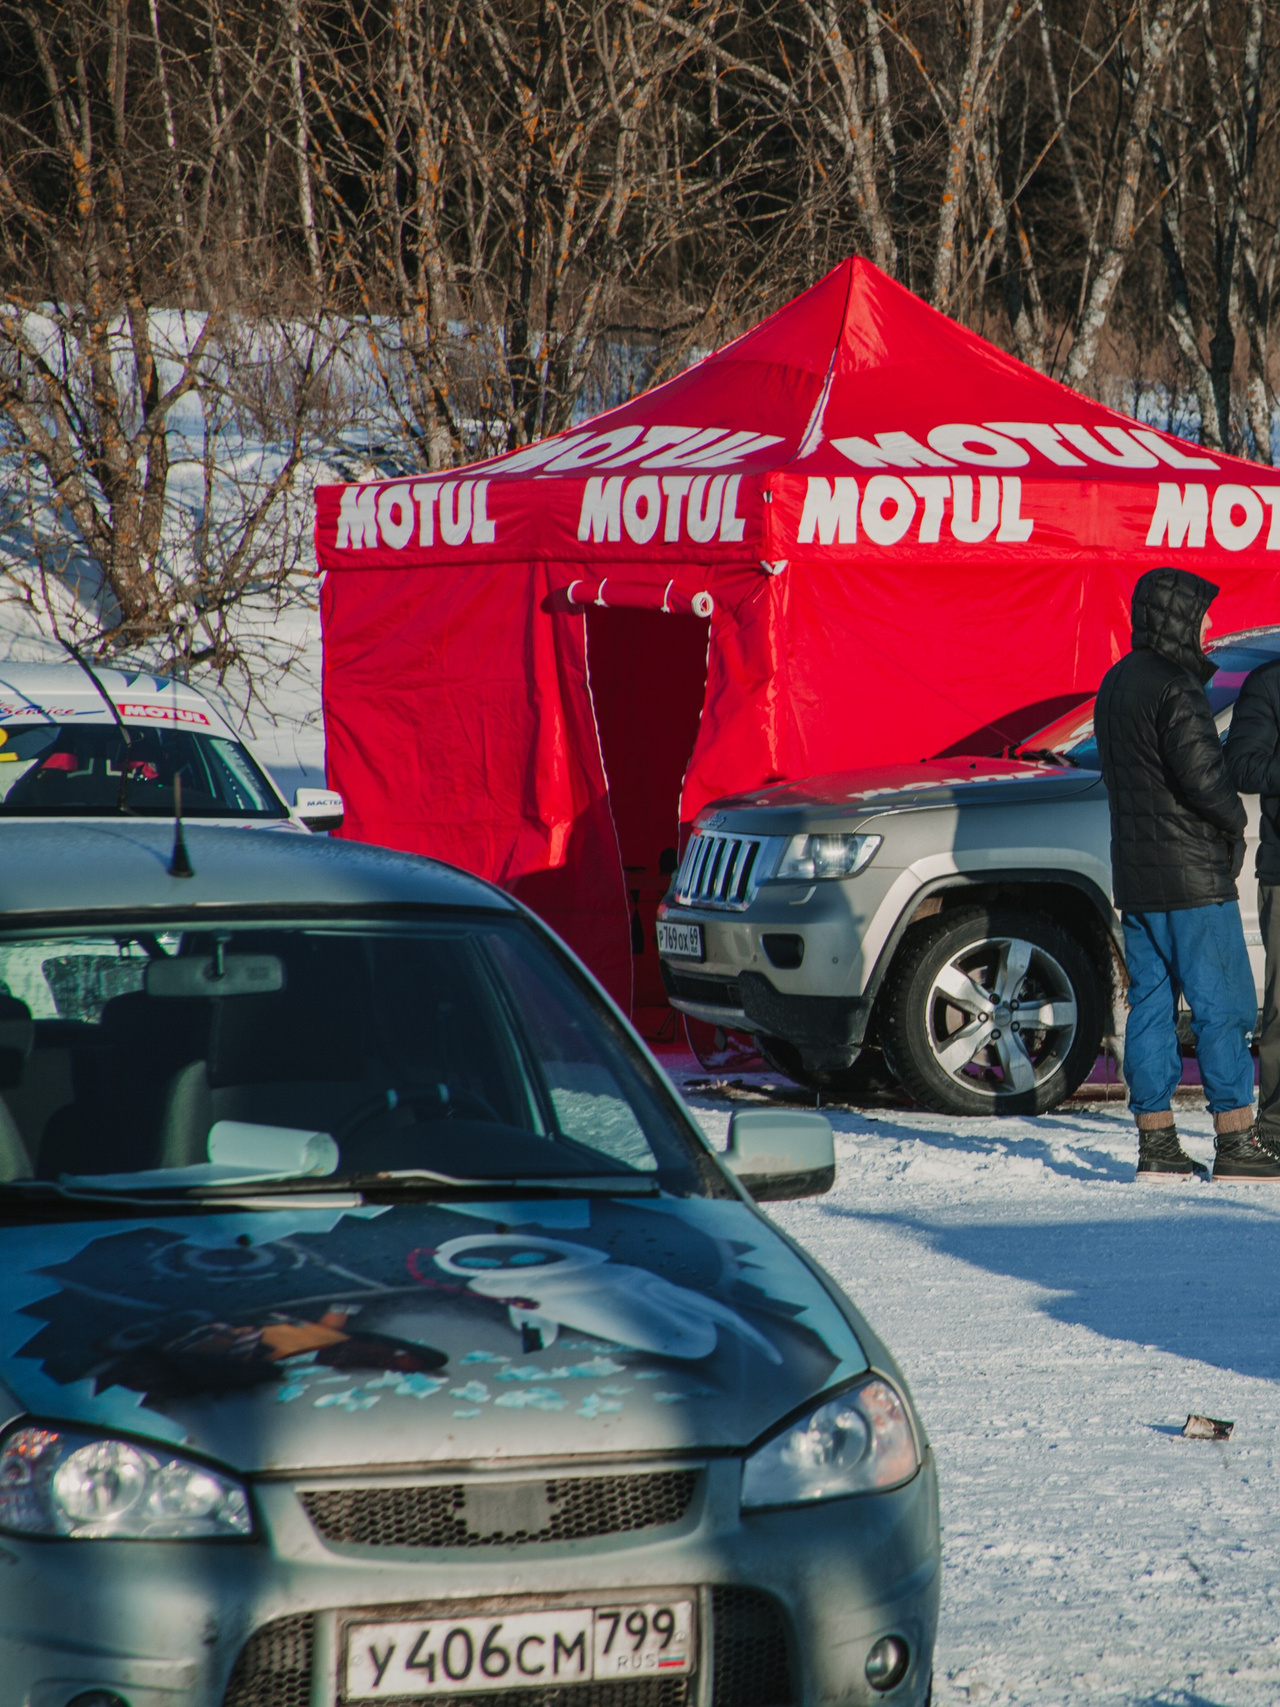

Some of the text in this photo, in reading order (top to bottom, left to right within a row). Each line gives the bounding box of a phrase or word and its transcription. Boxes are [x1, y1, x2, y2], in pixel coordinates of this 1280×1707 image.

[459, 425, 786, 472] MOTUL
[830, 421, 1221, 470] MOTUL
[336, 479, 496, 550] MOTUL
[577, 473, 746, 544] MOTUL
[797, 475, 1034, 546] MOTUL
[124, 704, 206, 725] MOTUL
[598, 1608, 675, 1655] 799
[617, 1653, 657, 1669] RUS
